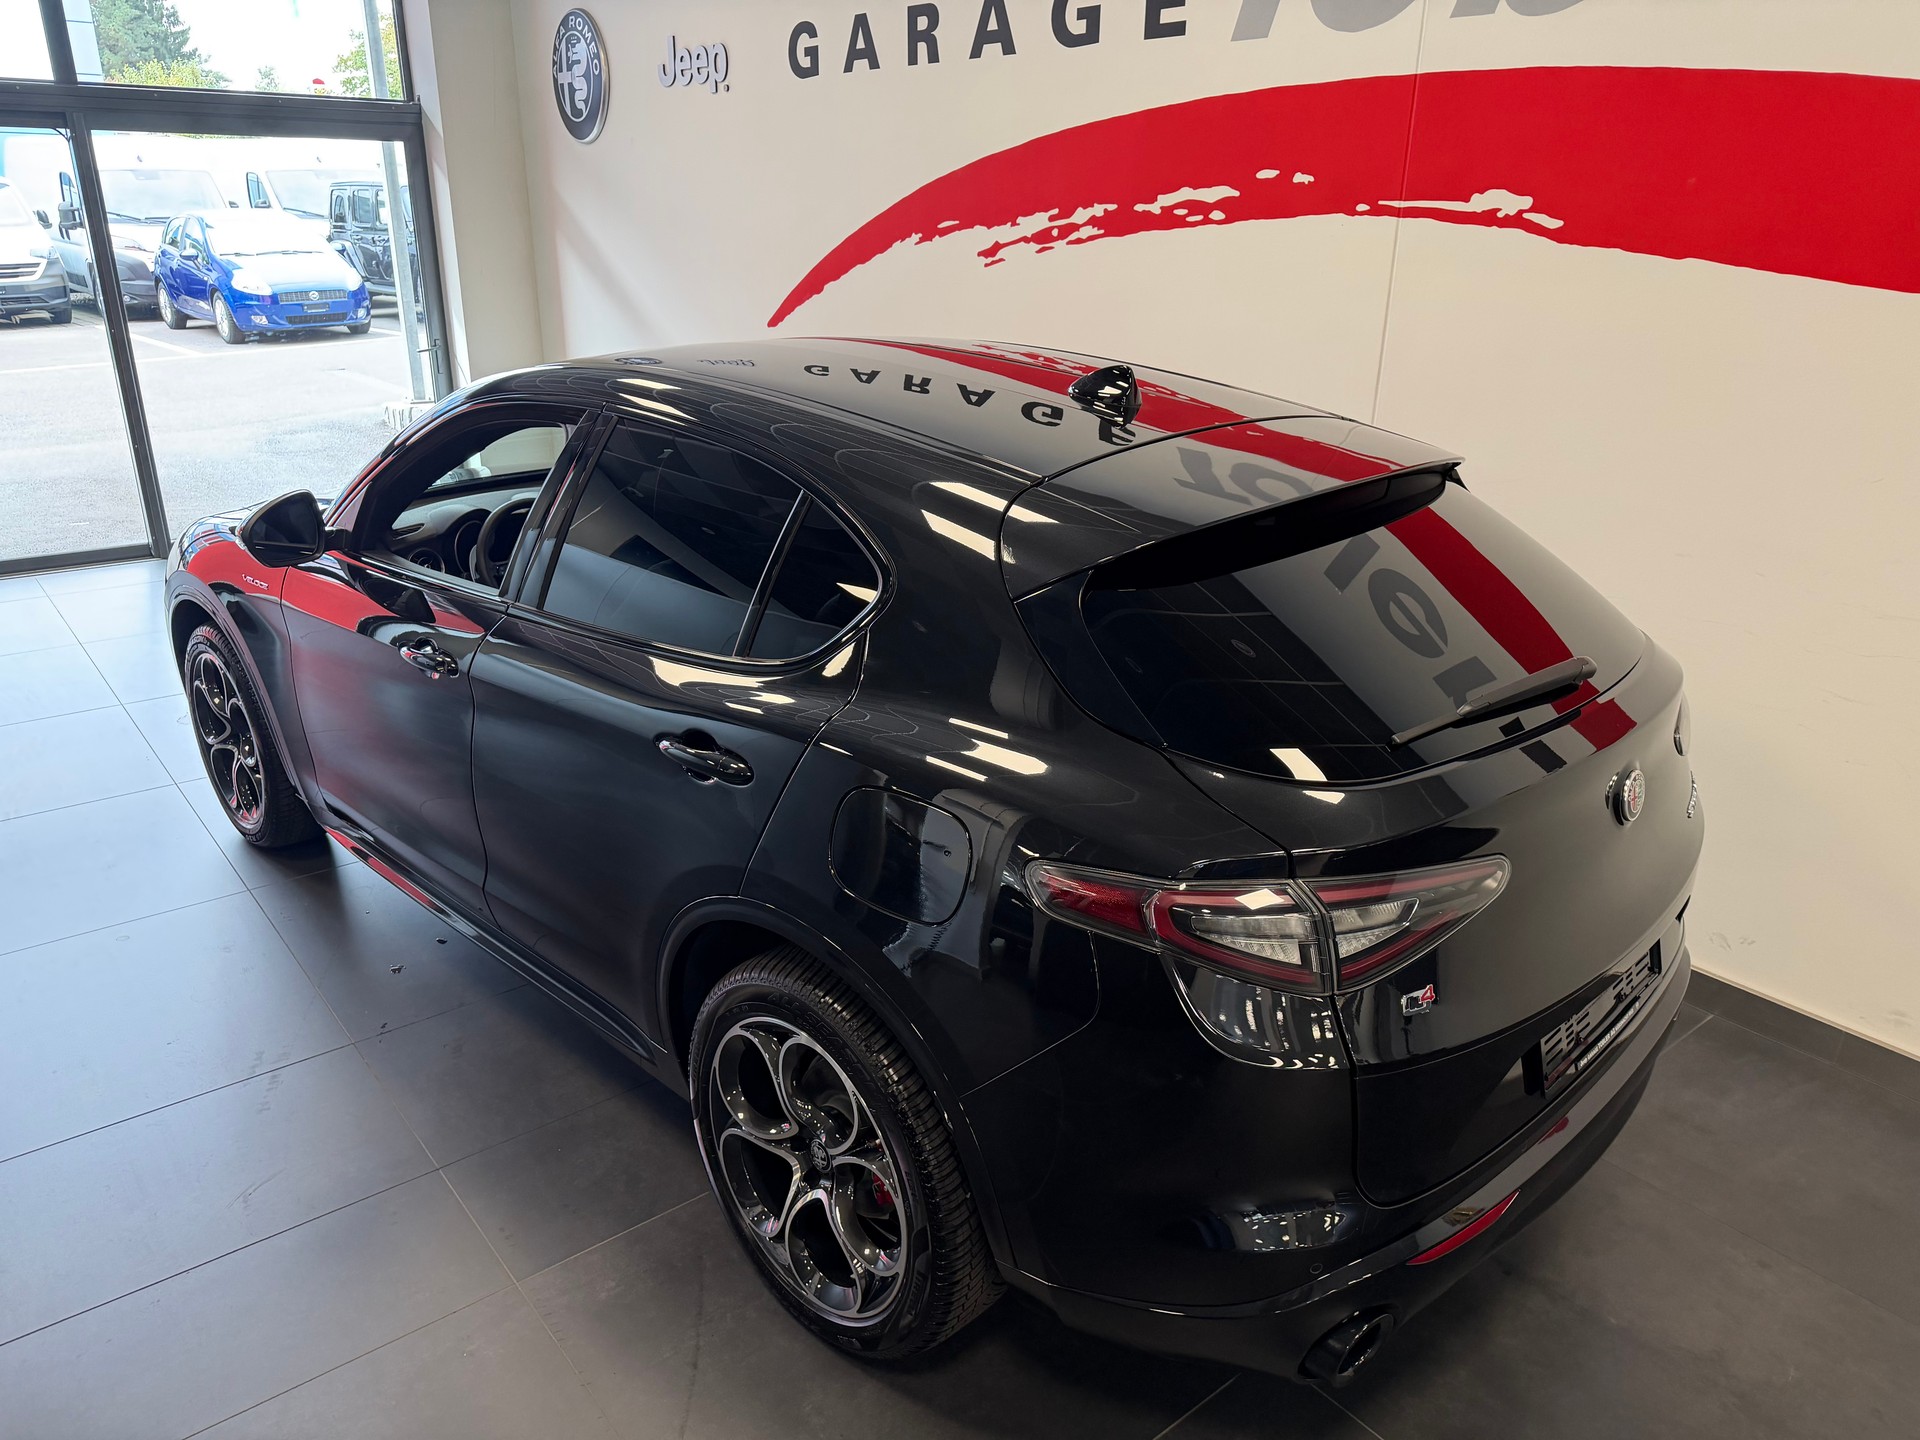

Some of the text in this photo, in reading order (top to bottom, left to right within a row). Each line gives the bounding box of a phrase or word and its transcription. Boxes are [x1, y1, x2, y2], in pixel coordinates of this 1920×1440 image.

[553, 15, 600, 79] ALFA ROMEO
[787, 0, 1187, 80] GARAGE
[242, 573, 269, 590] VELOCE
